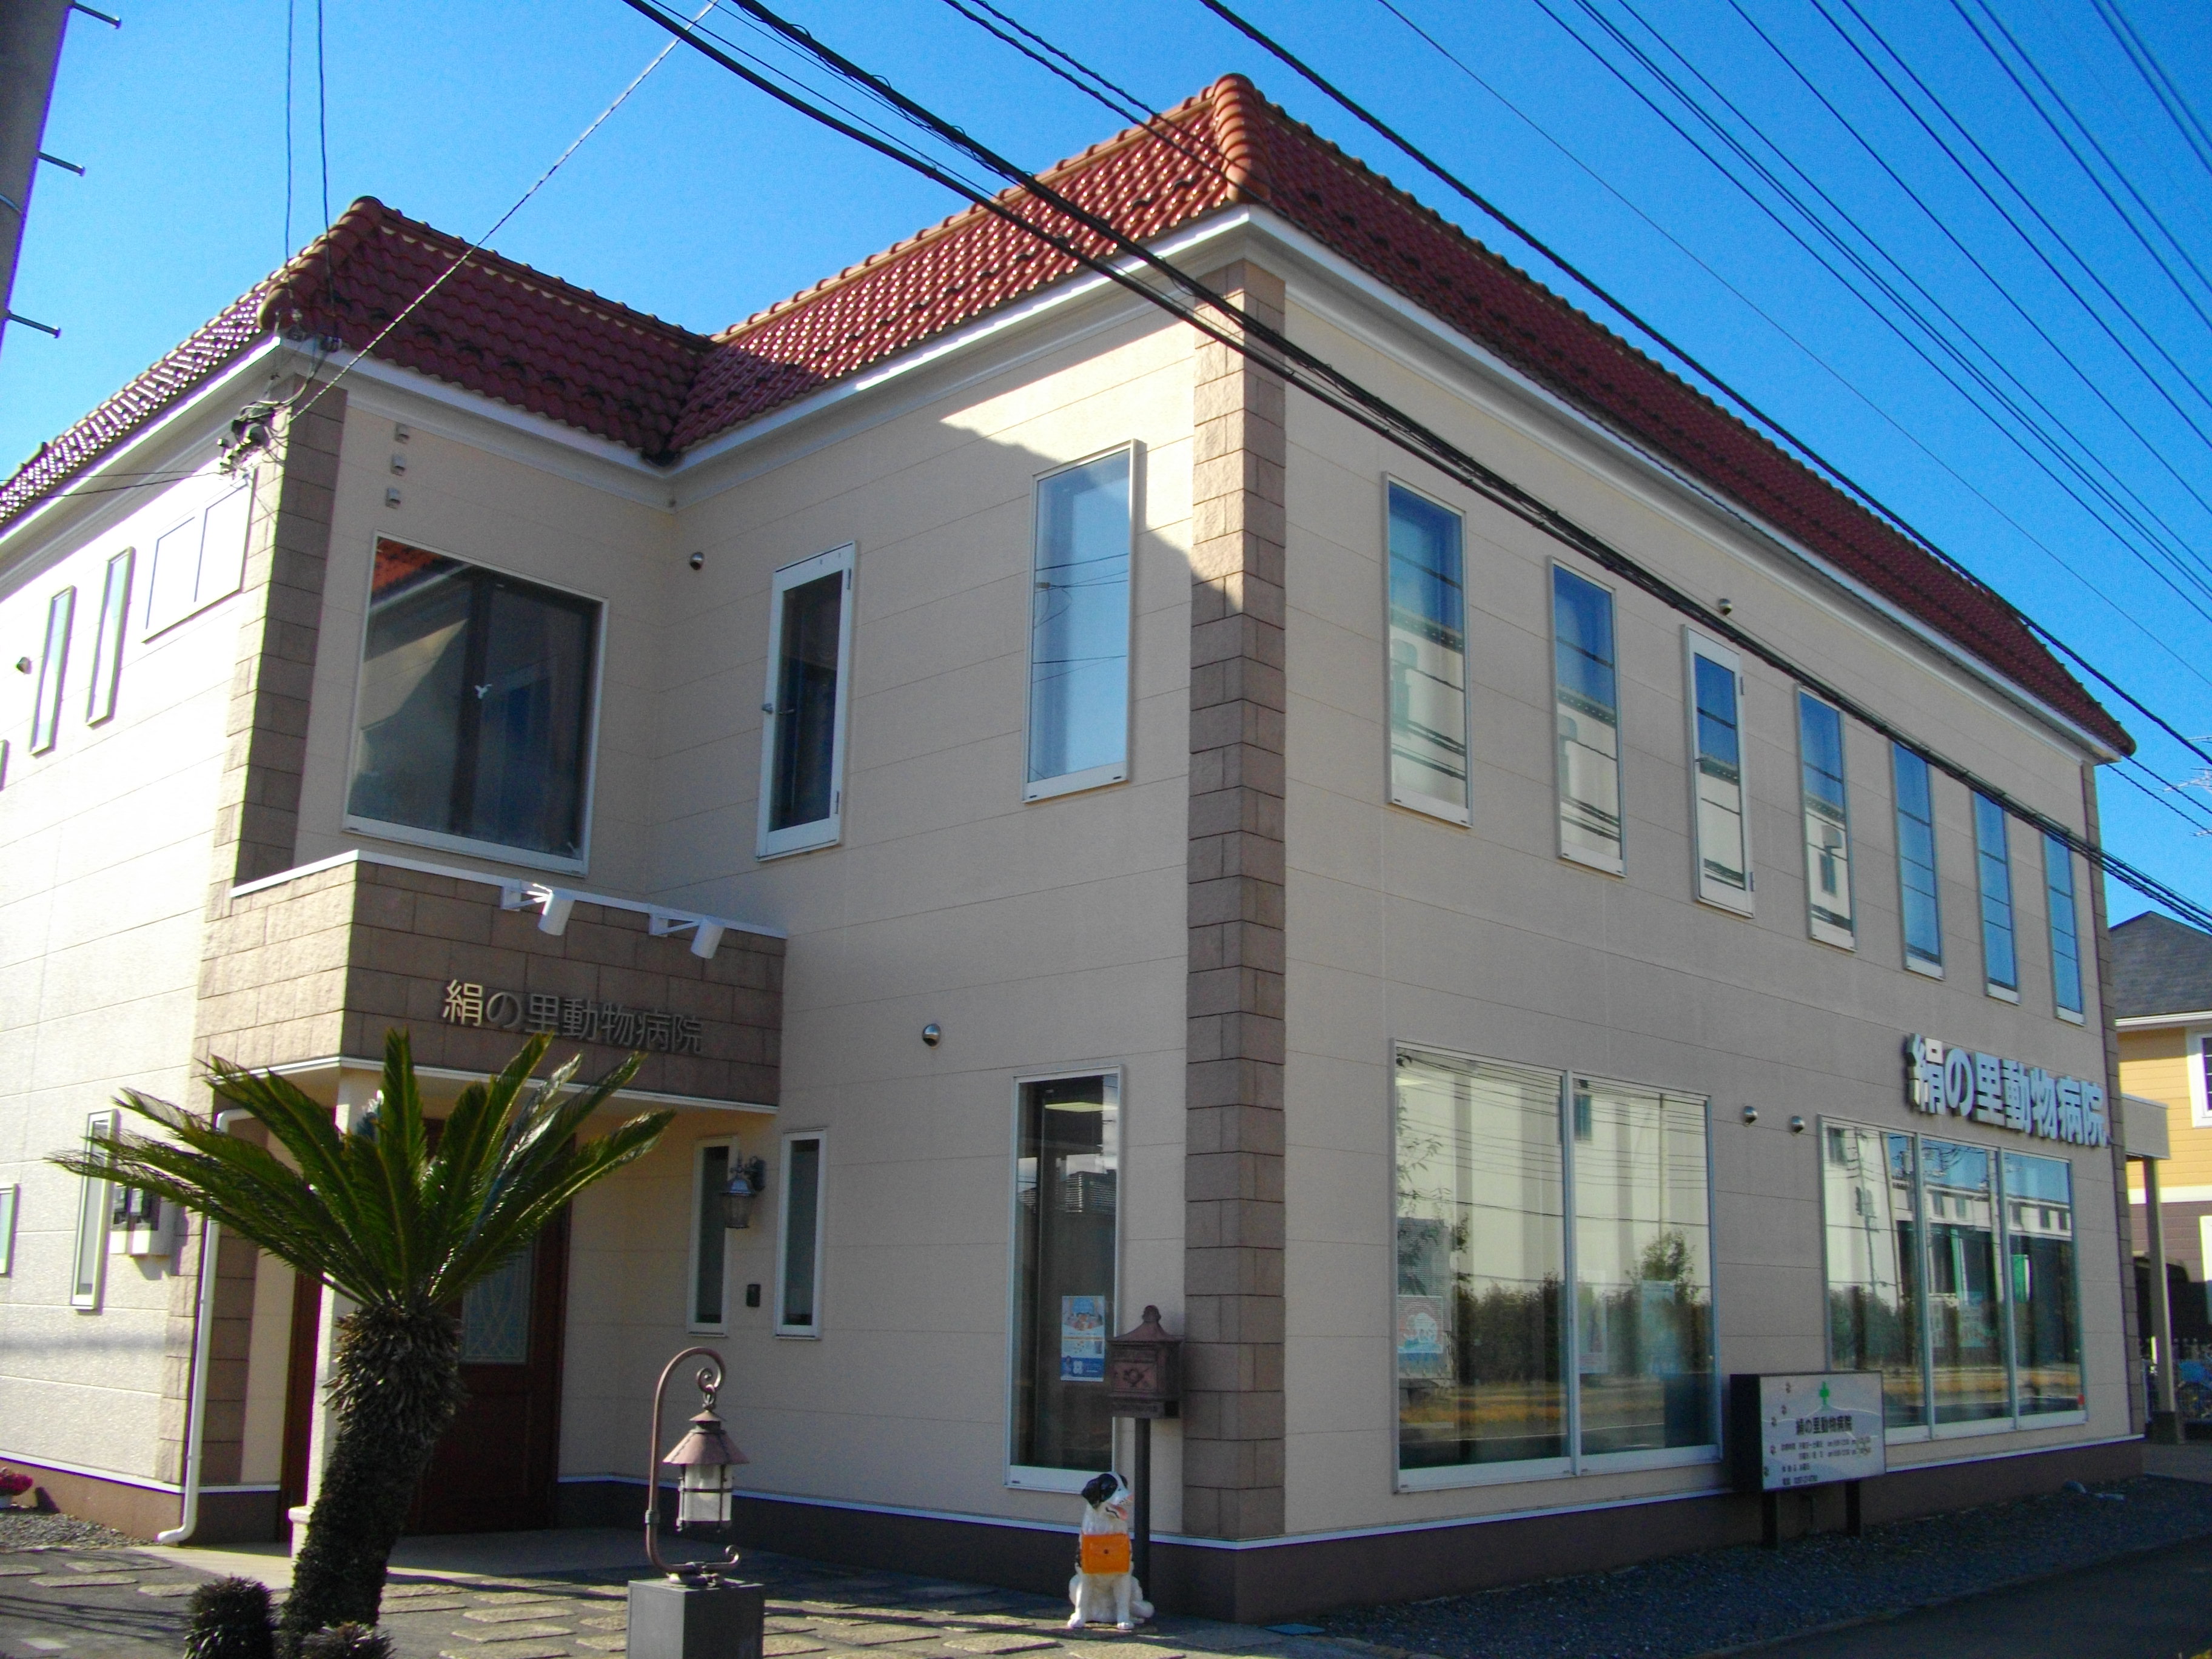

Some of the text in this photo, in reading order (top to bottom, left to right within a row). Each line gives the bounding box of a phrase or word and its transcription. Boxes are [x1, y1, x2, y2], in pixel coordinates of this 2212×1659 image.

[443, 979, 702, 1053] 絹の里動物病院
[1905, 1033, 2108, 1147] 絹の里動物病院
